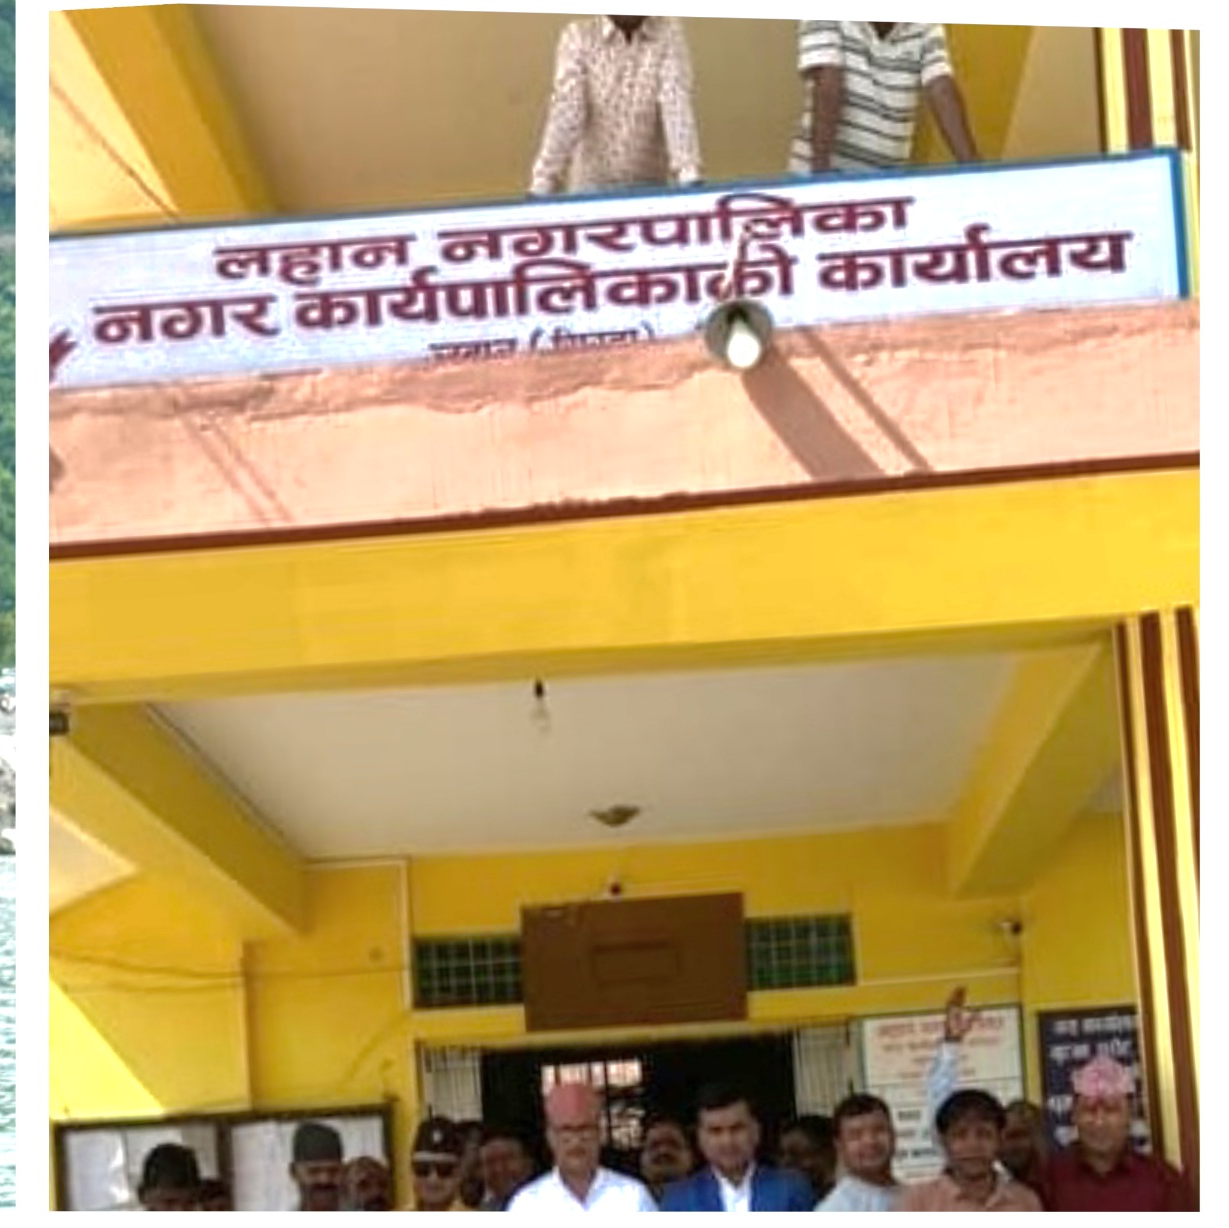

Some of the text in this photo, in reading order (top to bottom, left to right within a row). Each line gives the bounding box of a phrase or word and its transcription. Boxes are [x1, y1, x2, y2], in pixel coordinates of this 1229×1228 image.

[92, 223, 1135, 346] नगर कार्यपालिकाको कार्यालय
[214, 192, 915, 285] लहान नगरपालिका
